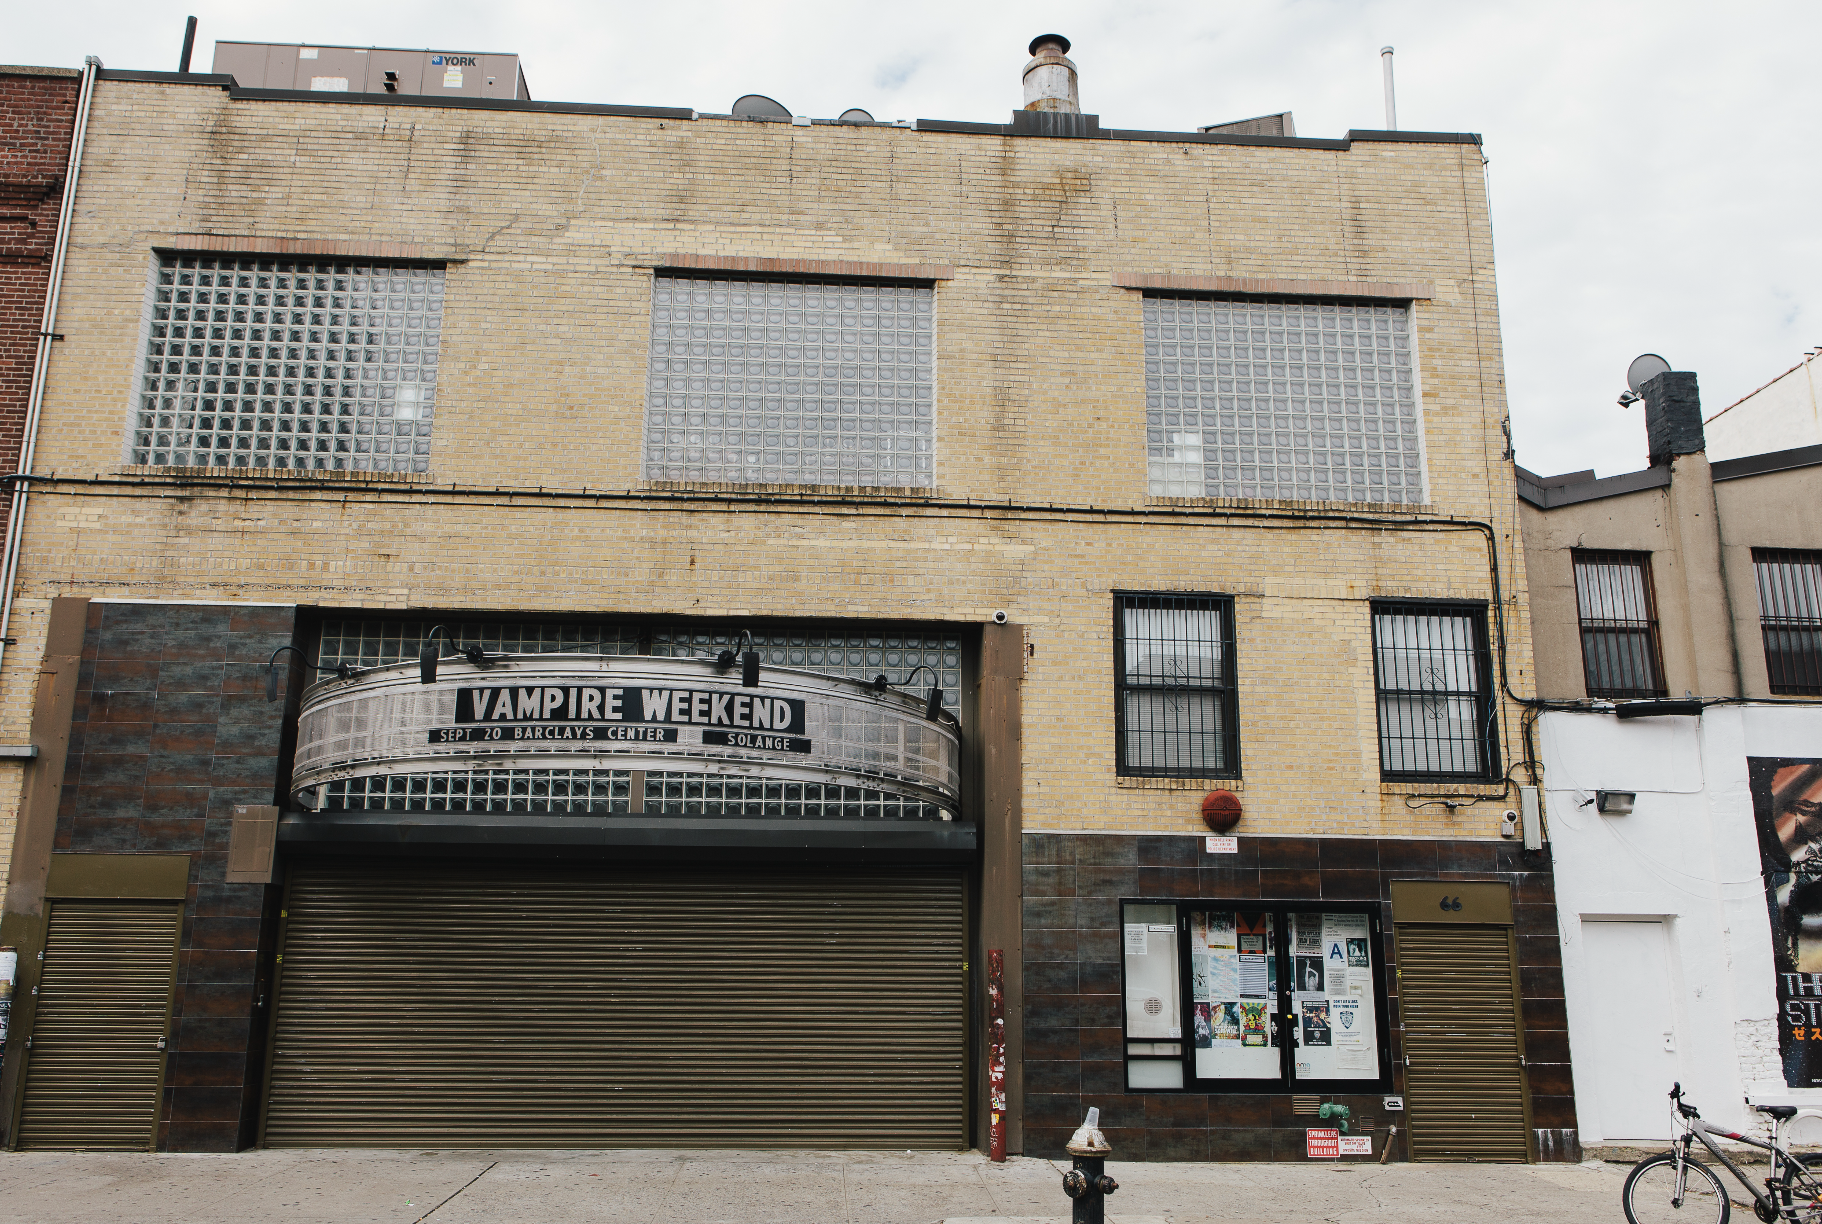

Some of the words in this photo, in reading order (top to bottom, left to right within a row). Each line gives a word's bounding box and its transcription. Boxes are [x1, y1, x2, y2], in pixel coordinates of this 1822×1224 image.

[443, 56, 476, 67] YORK
[472, 687, 624, 721] VAMPIRE
[641, 688, 792, 730] WEEKEND
[440, 728, 472, 742] SEPT
[484, 727, 502, 740] 20
[514, 727, 594, 740] BARCLAYS
[607, 727, 664, 741] CENTER
[727, 733, 790, 751] SOLANGE
[1439, 895, 1463, 911] 66
[1330, 943, 1344, 959] A
